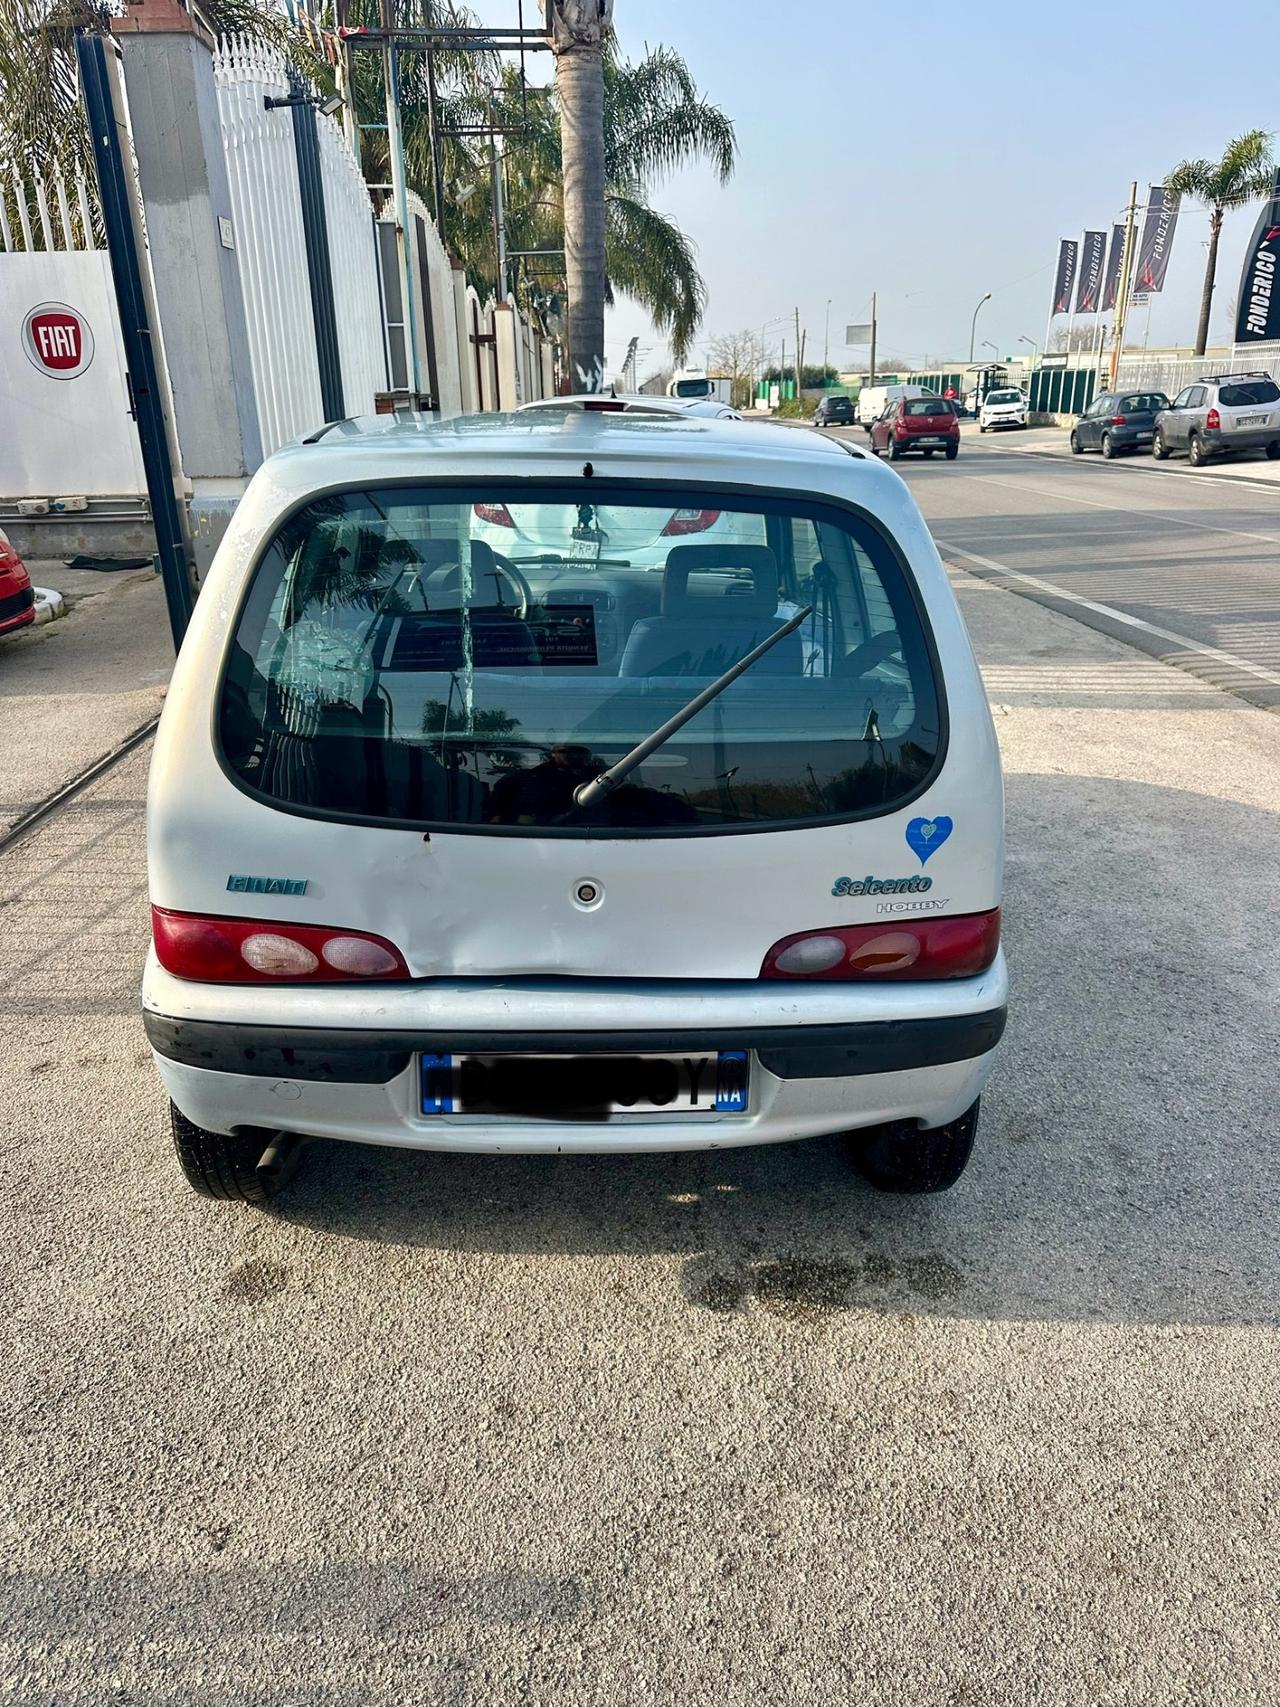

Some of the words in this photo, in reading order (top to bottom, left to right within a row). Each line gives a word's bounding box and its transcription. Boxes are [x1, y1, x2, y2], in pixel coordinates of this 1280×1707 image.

[1153, 190, 1172, 260] FONDERICO
[1089, 234, 1102, 288] FONDERICO
[1246, 250, 1277, 335] FONDERICO
[38, 326, 77, 357] FIAT
[228, 875, 306, 895] FIAT
[831, 874, 933, 897] Seicento
[876, 899, 951, 913] HOBBY
[718, 1086, 741, 1102] NA
